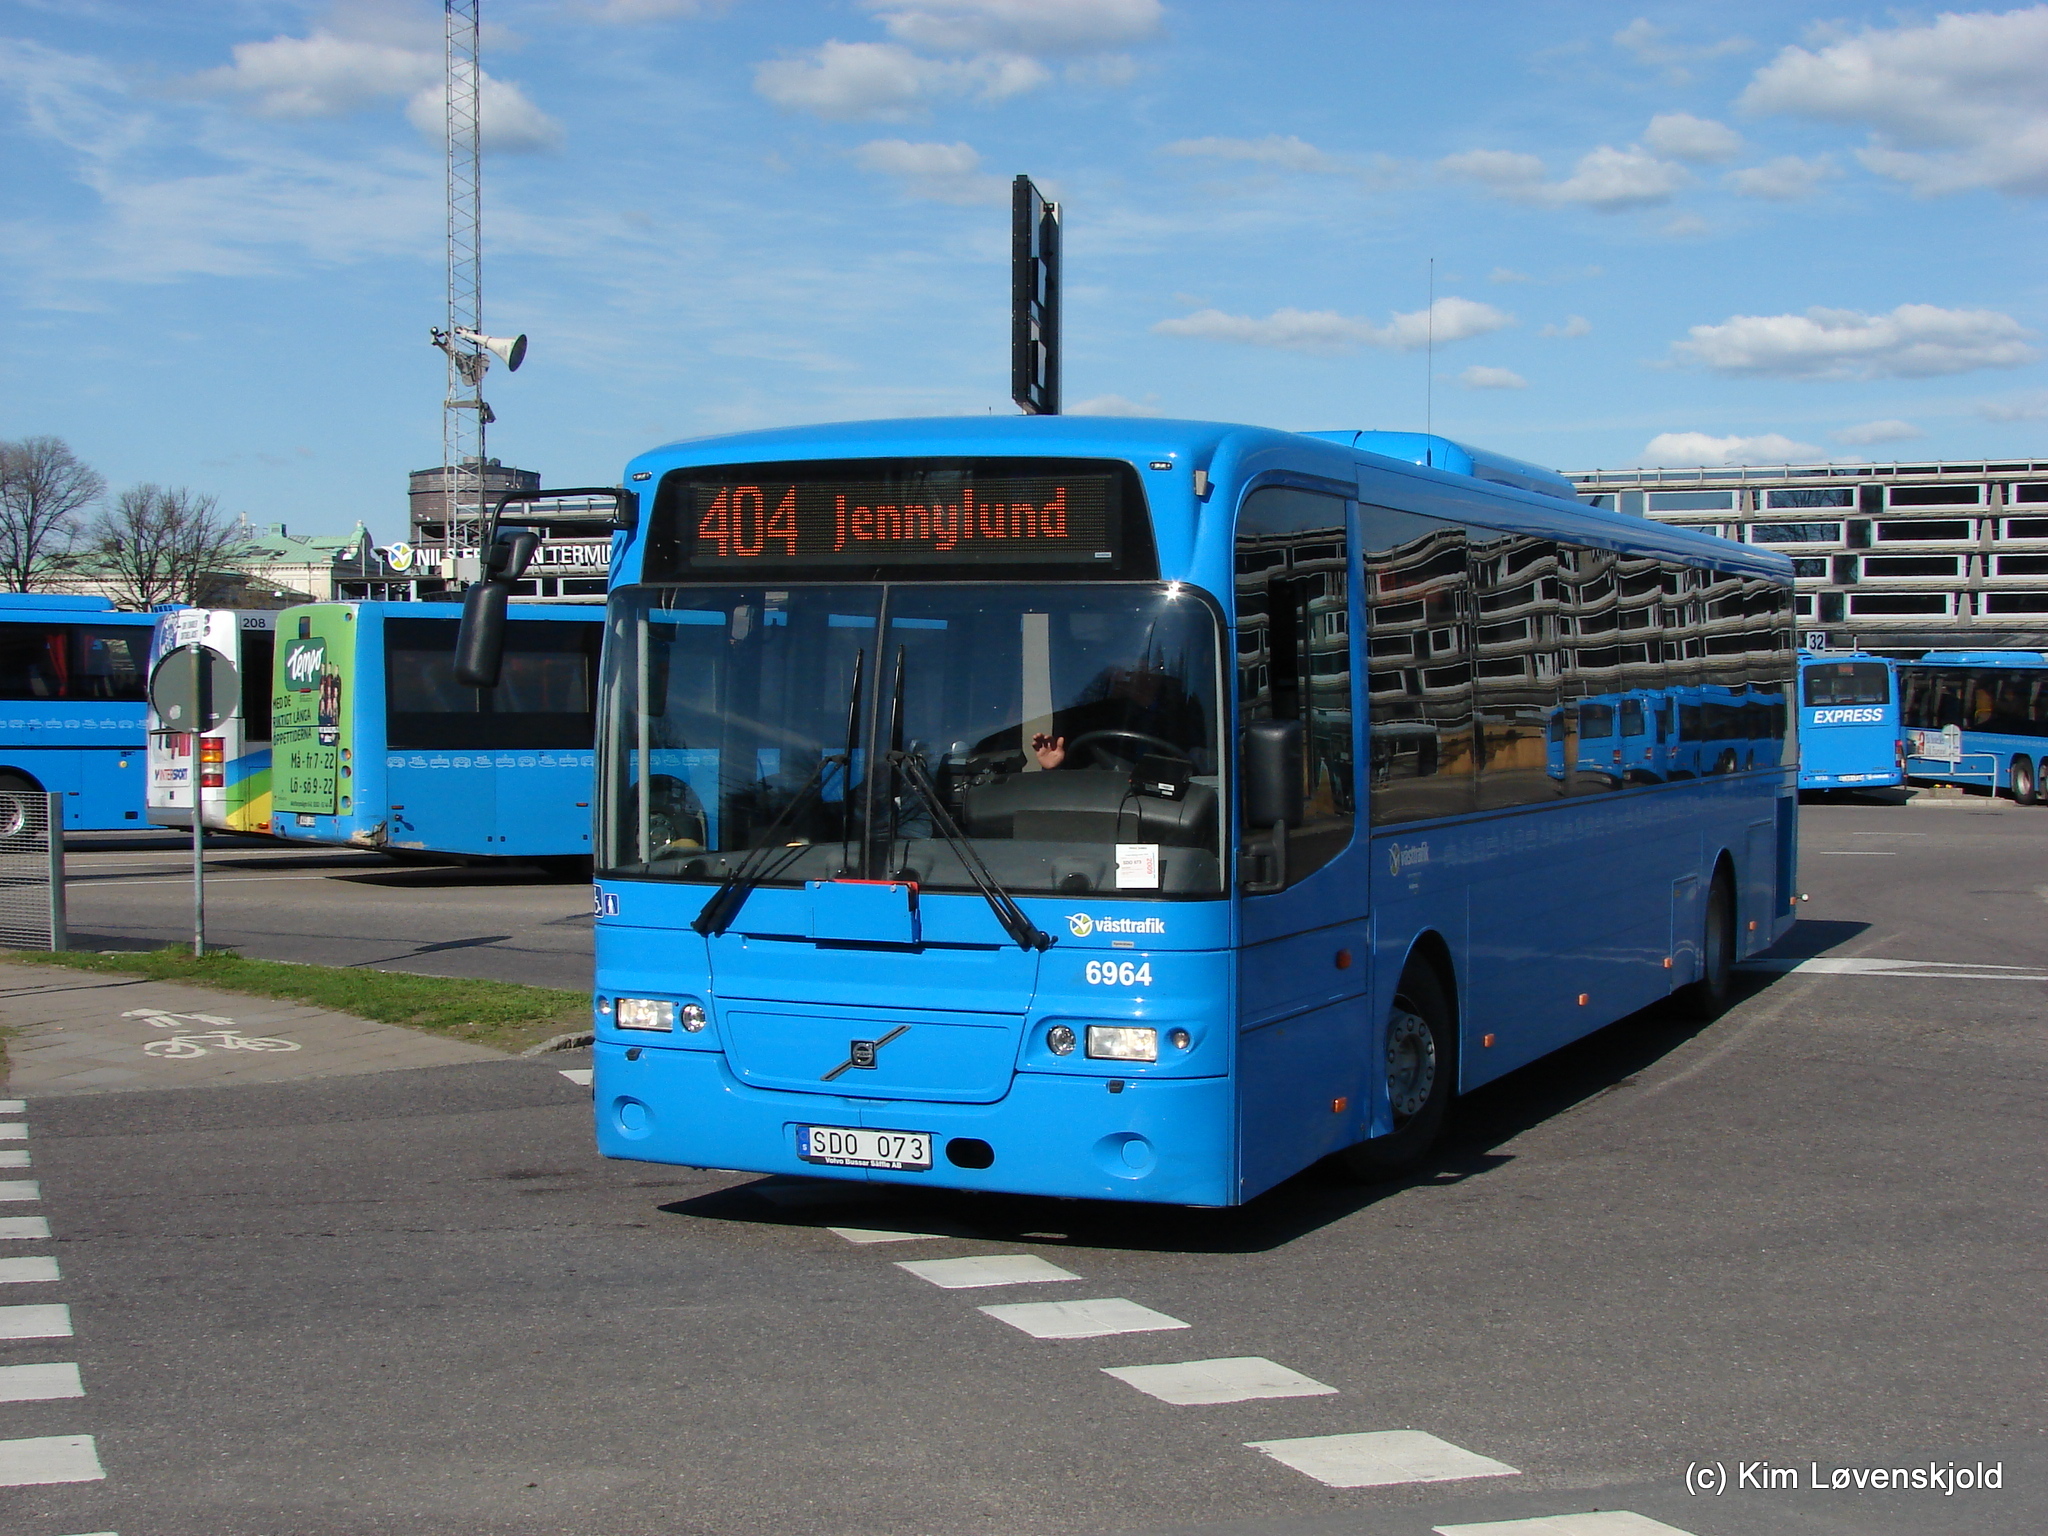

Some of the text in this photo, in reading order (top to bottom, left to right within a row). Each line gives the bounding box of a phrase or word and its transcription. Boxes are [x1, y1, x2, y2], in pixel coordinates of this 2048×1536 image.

[698, 485, 1068, 557] 404 Jennylund
[243, 618, 266, 628] 208
[1809, 634, 1824, 650] 32
[1813, 708, 1883, 724] EXPRESS
[324, 753, 334, 769] 22
[323, 778, 333, 794] 22
[1094, 916, 1165, 934] västtrafik
[1085, 960, 1153, 986] 6964
[813, 1131, 858, 1155] SDO
[877, 1136, 924, 1160] 073
[825, 1156, 844, 1165] Volvo
